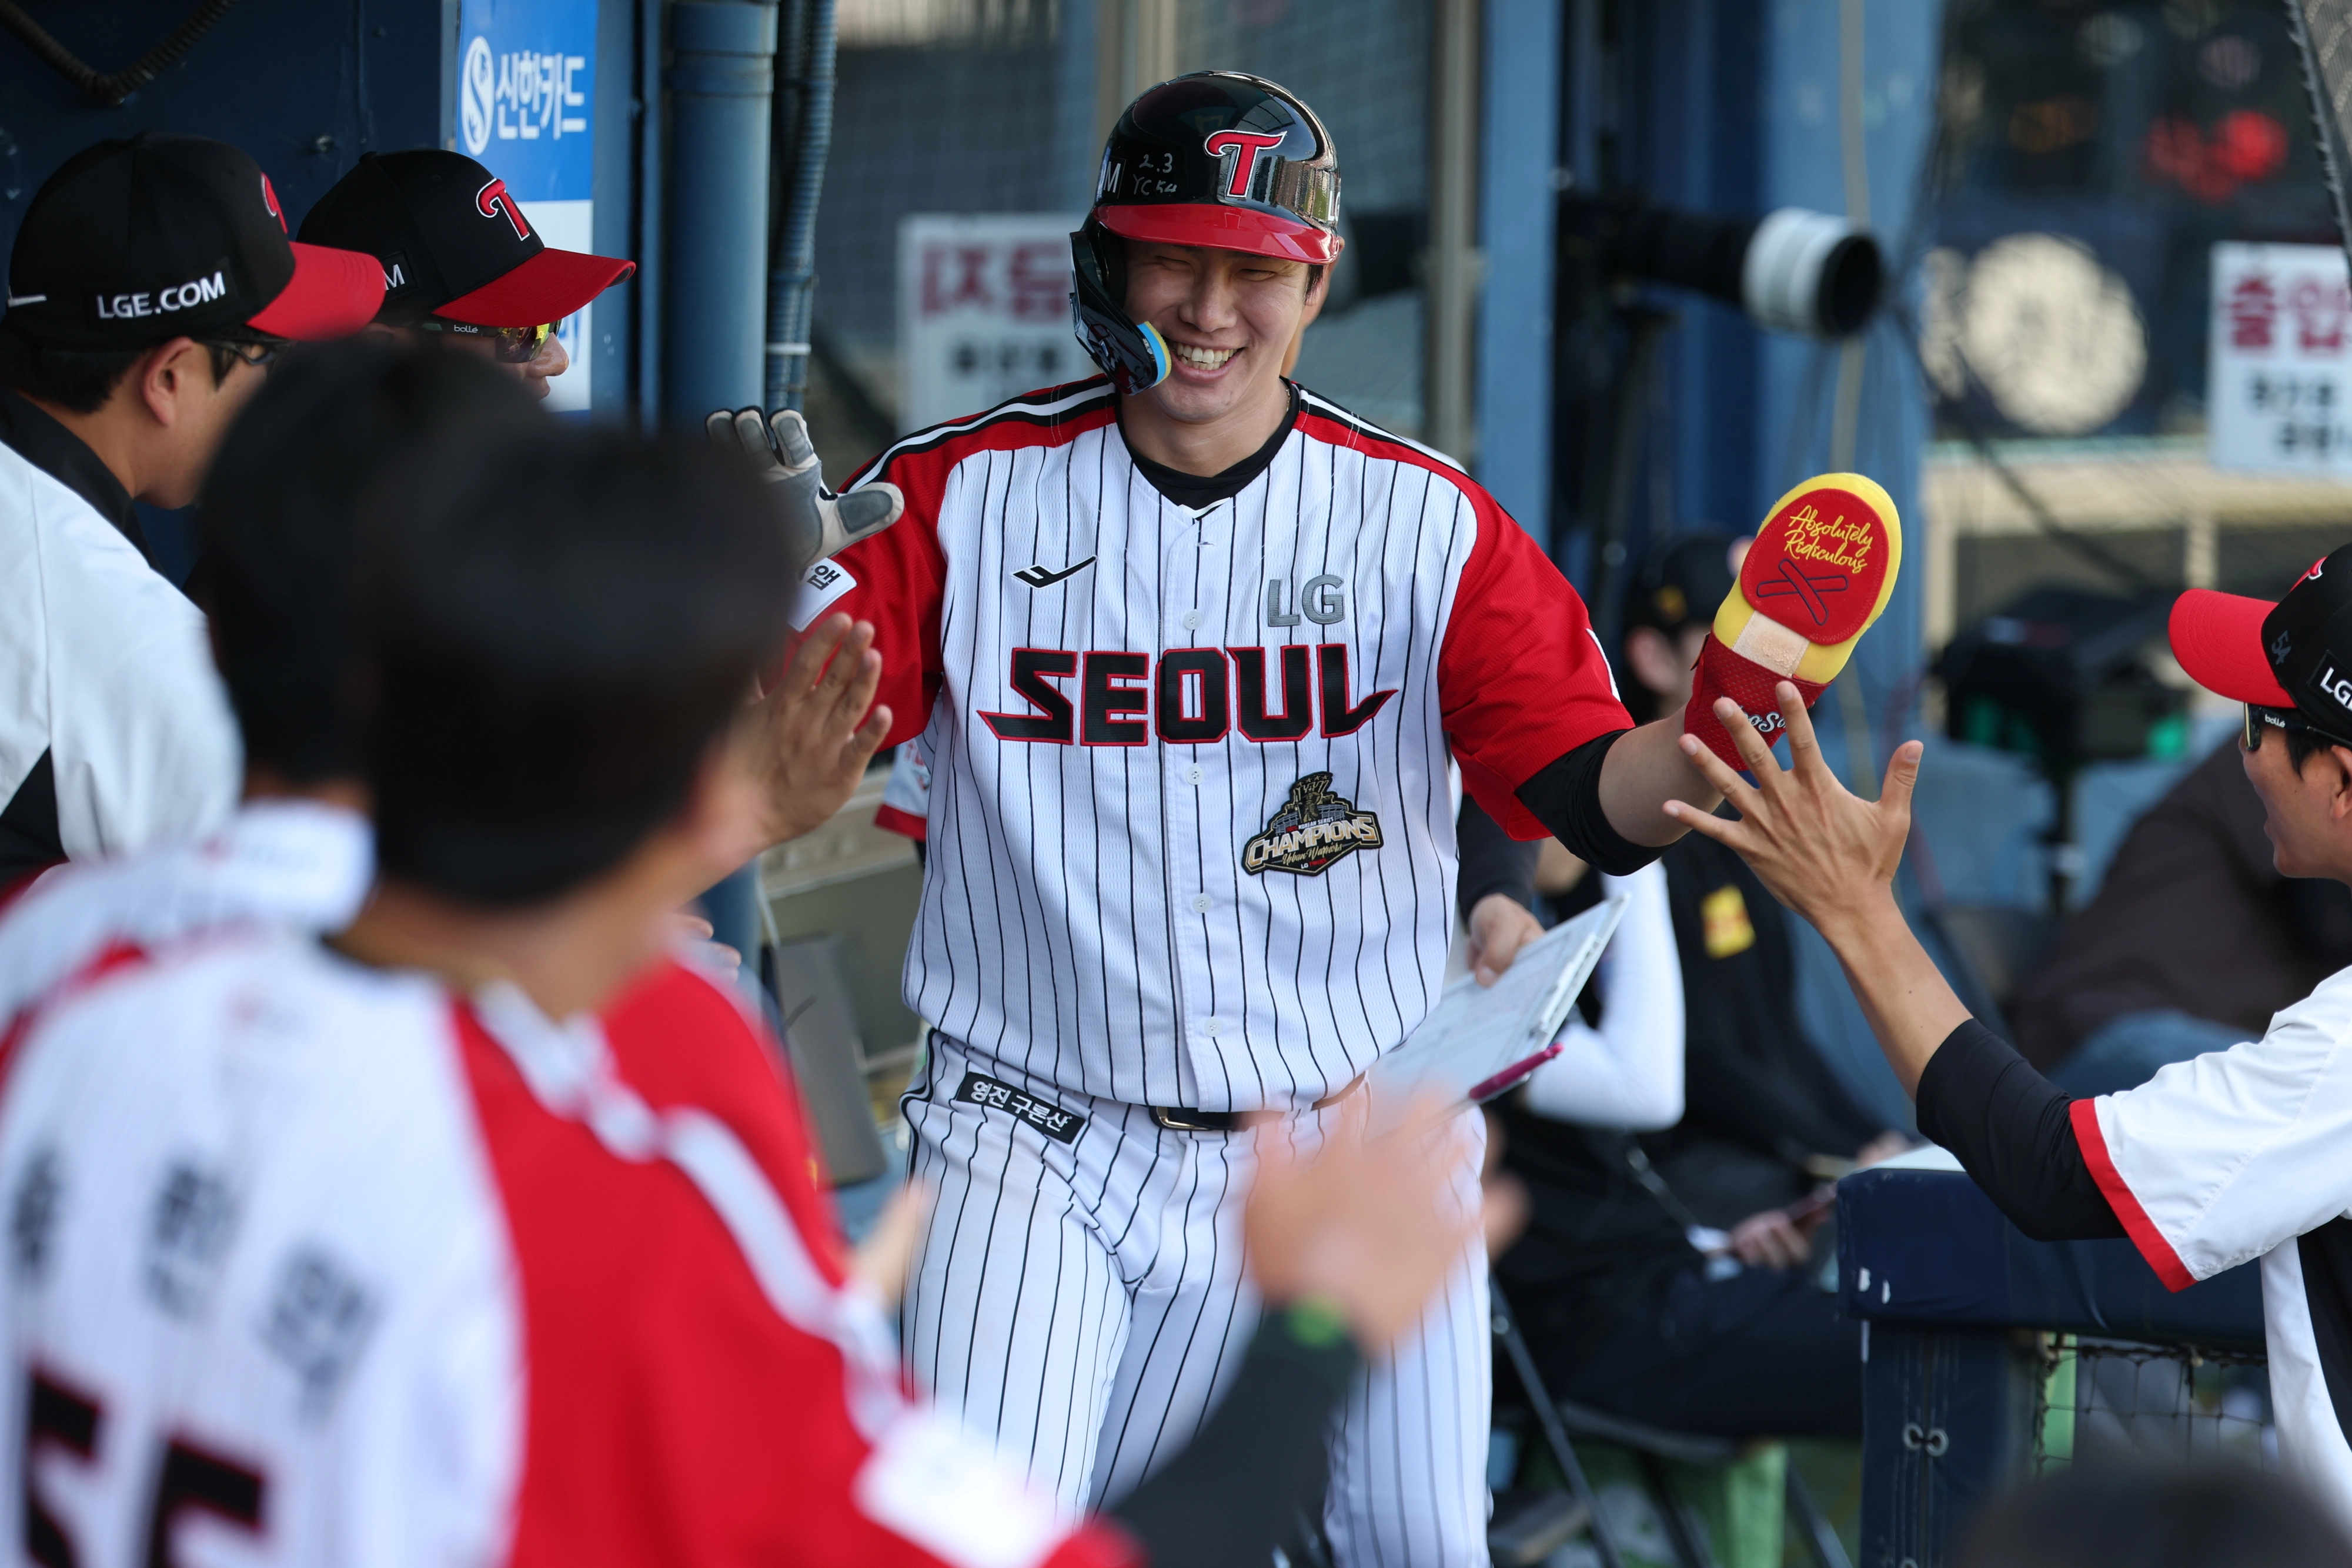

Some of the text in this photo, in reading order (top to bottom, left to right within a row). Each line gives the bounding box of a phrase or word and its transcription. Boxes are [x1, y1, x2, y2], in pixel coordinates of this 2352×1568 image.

[495, 49, 587, 141] 신한카드
[1204, 129, 1287, 199] T
[96, 270, 226, 319] LGE.COM
[1784, 529, 1868, 574] Ridiculous
[1788, 504, 1873, 558] Absolutely
[1267, 574, 1345, 627] LG
[977, 643, 1399, 747] SEOUL
[2320, 666, 2352, 711] LG
[1247, 816, 1378, 868] CHAMPIONS
[1282, 851, 1307, 867] Urban
[971, 1081, 1070, 1132] 영진 구론산
